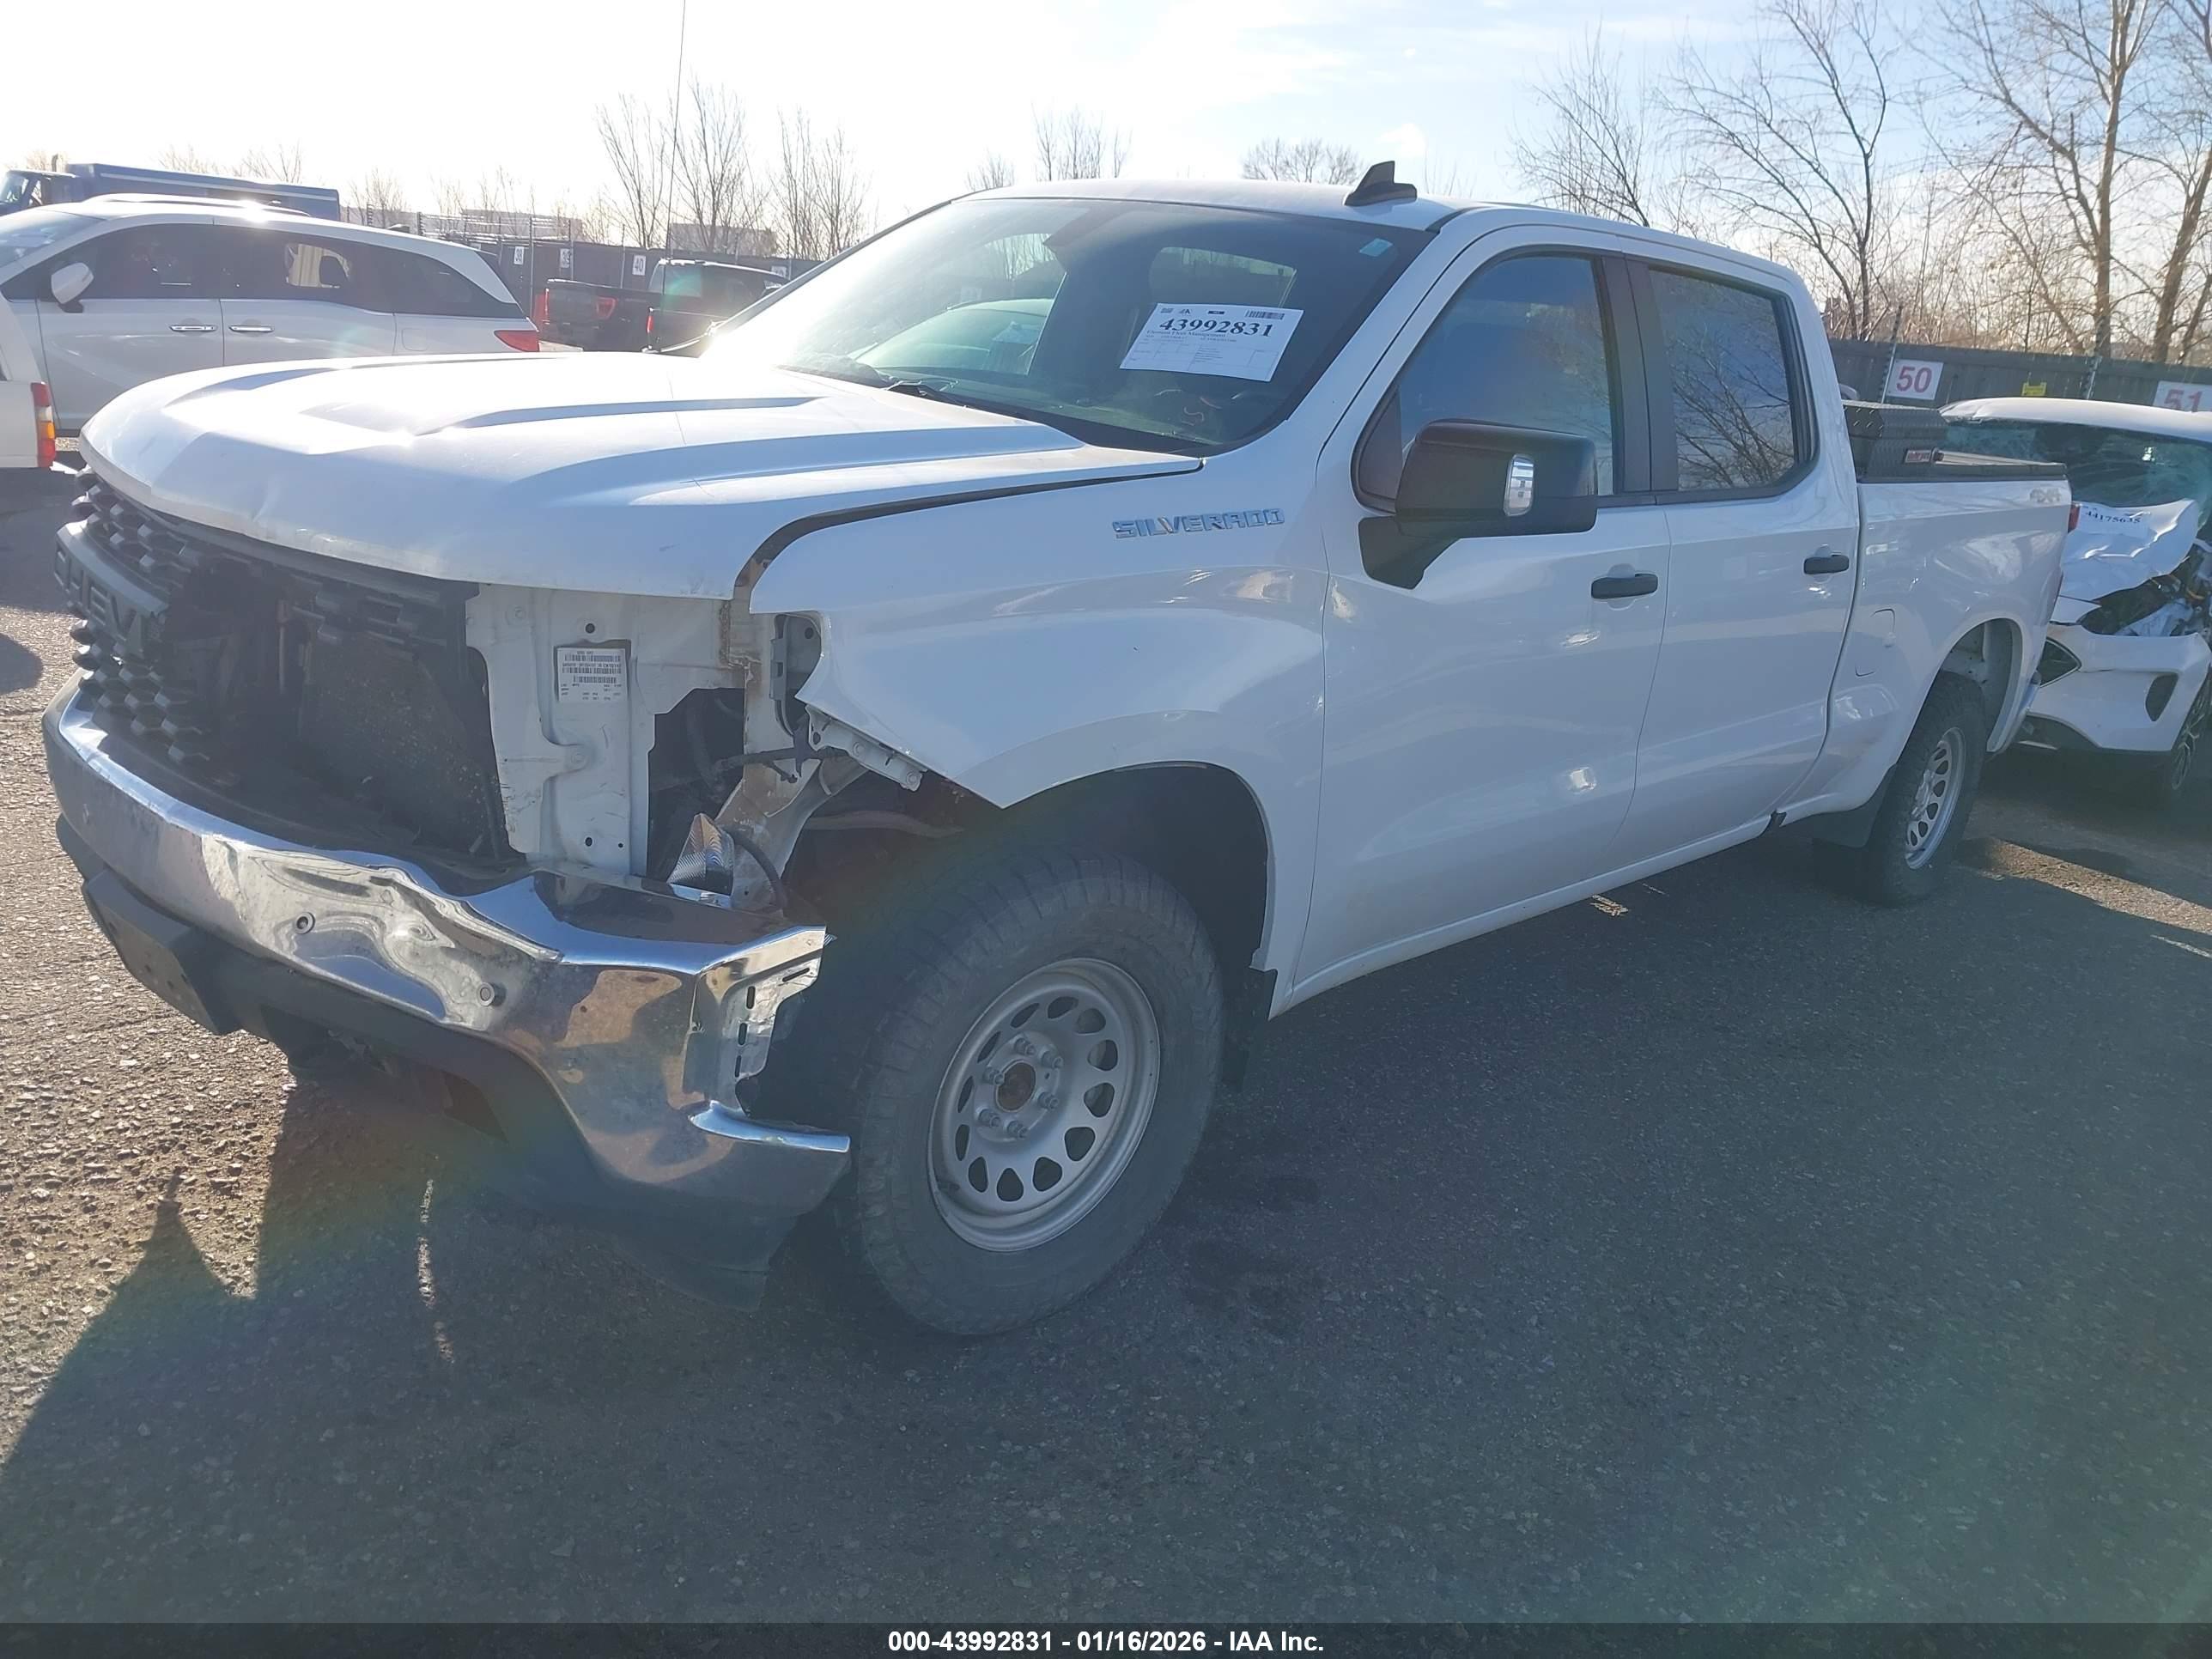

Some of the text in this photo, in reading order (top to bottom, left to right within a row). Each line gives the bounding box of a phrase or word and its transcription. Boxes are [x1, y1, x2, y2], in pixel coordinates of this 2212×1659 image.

[635, 258, 643, 272] 40
[1159, 319, 1273, 337] 43992831
[1896, 366, 1932, 393] 50
[2164, 389, 2203, 412] 51
[1112, 508, 1285, 539] SILVERADO
